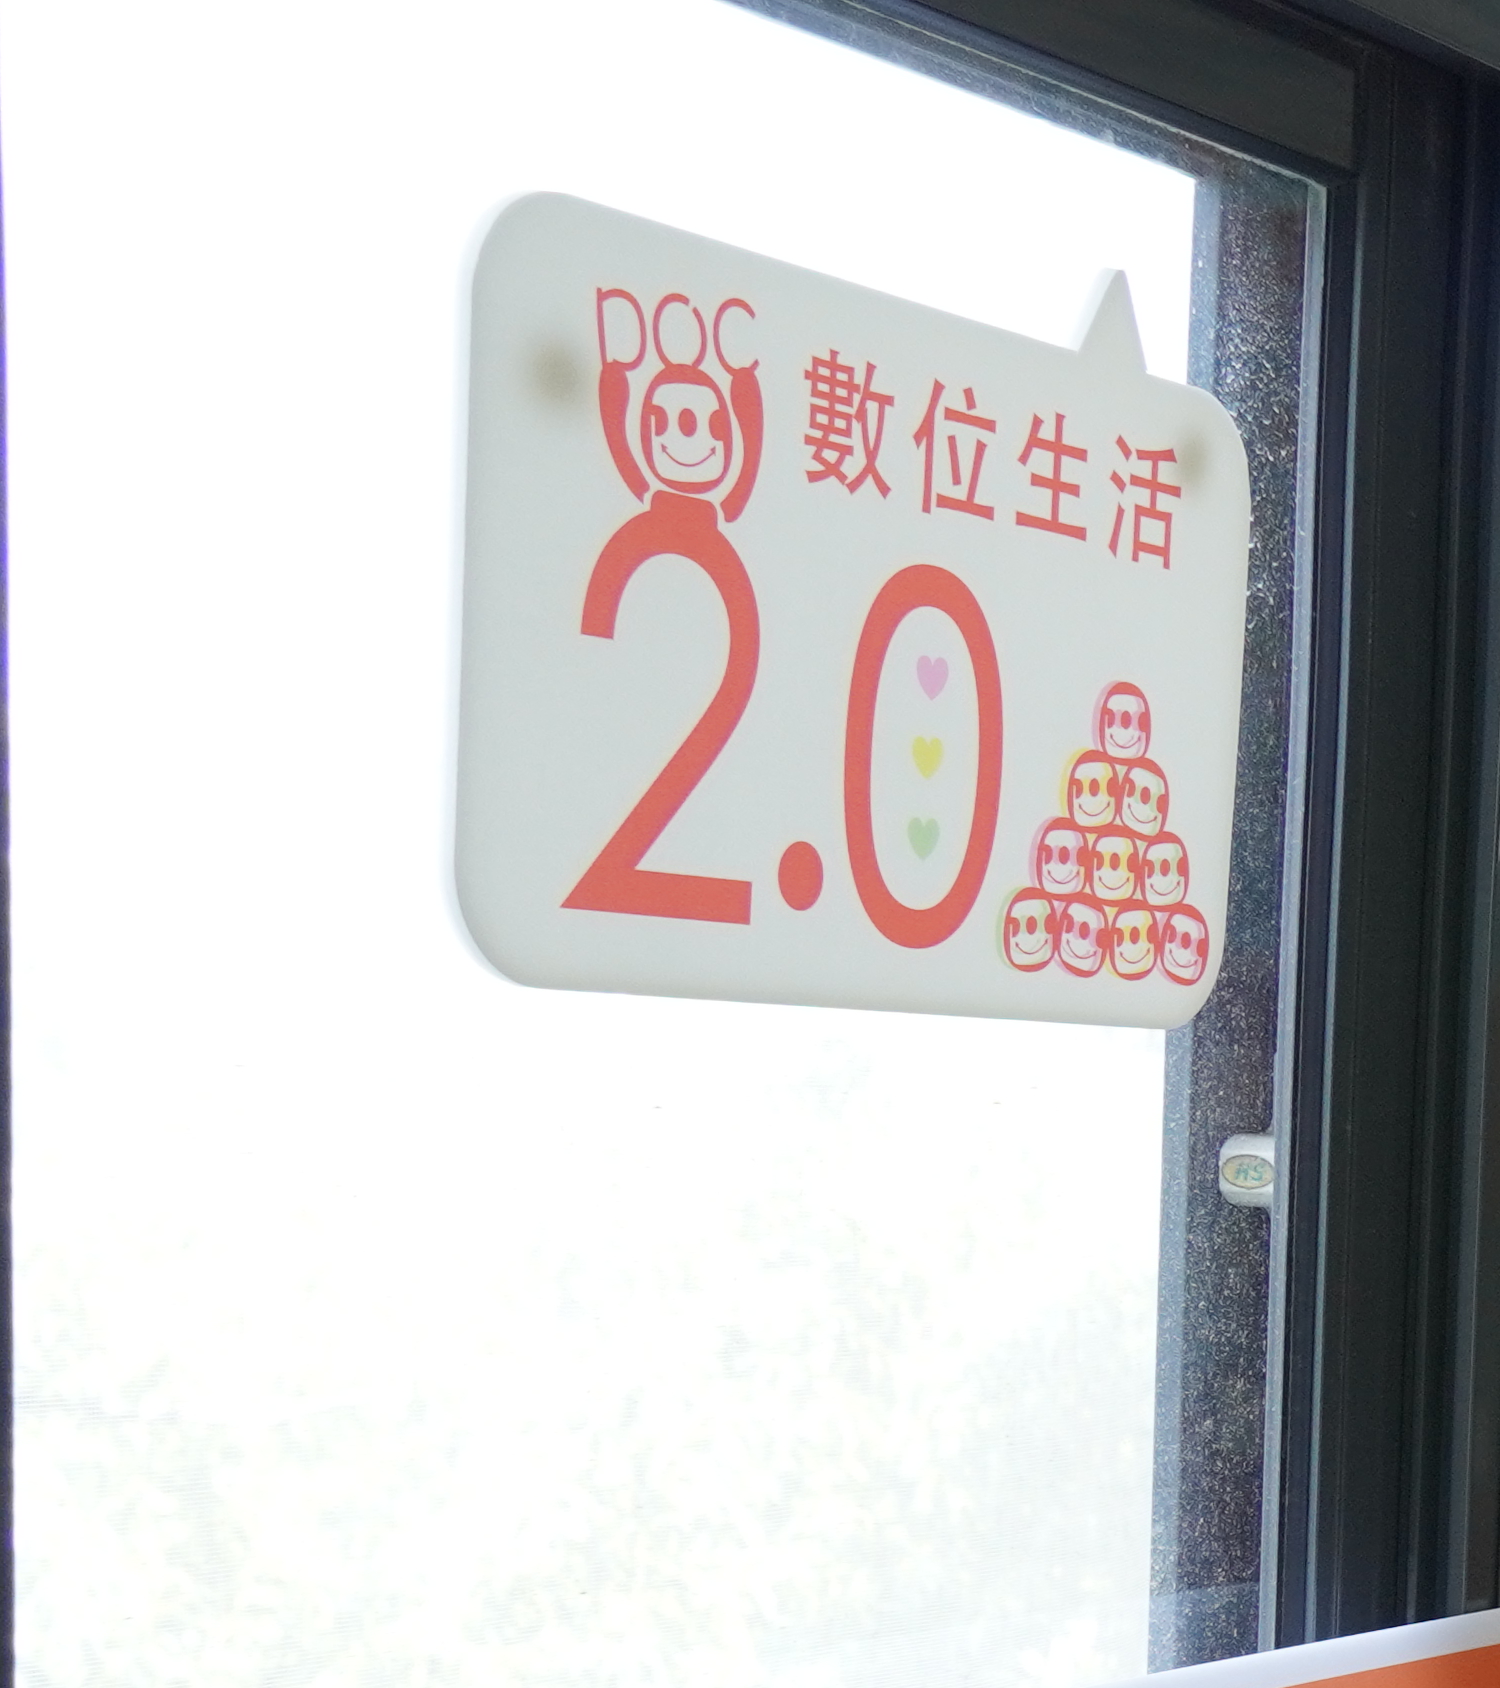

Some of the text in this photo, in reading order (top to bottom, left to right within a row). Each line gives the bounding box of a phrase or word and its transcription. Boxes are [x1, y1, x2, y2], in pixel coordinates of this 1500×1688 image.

[597, 287, 760, 372] DOC
[803, 349, 1182, 571] 數位生活
[561, 502, 1004, 950] 2.0
